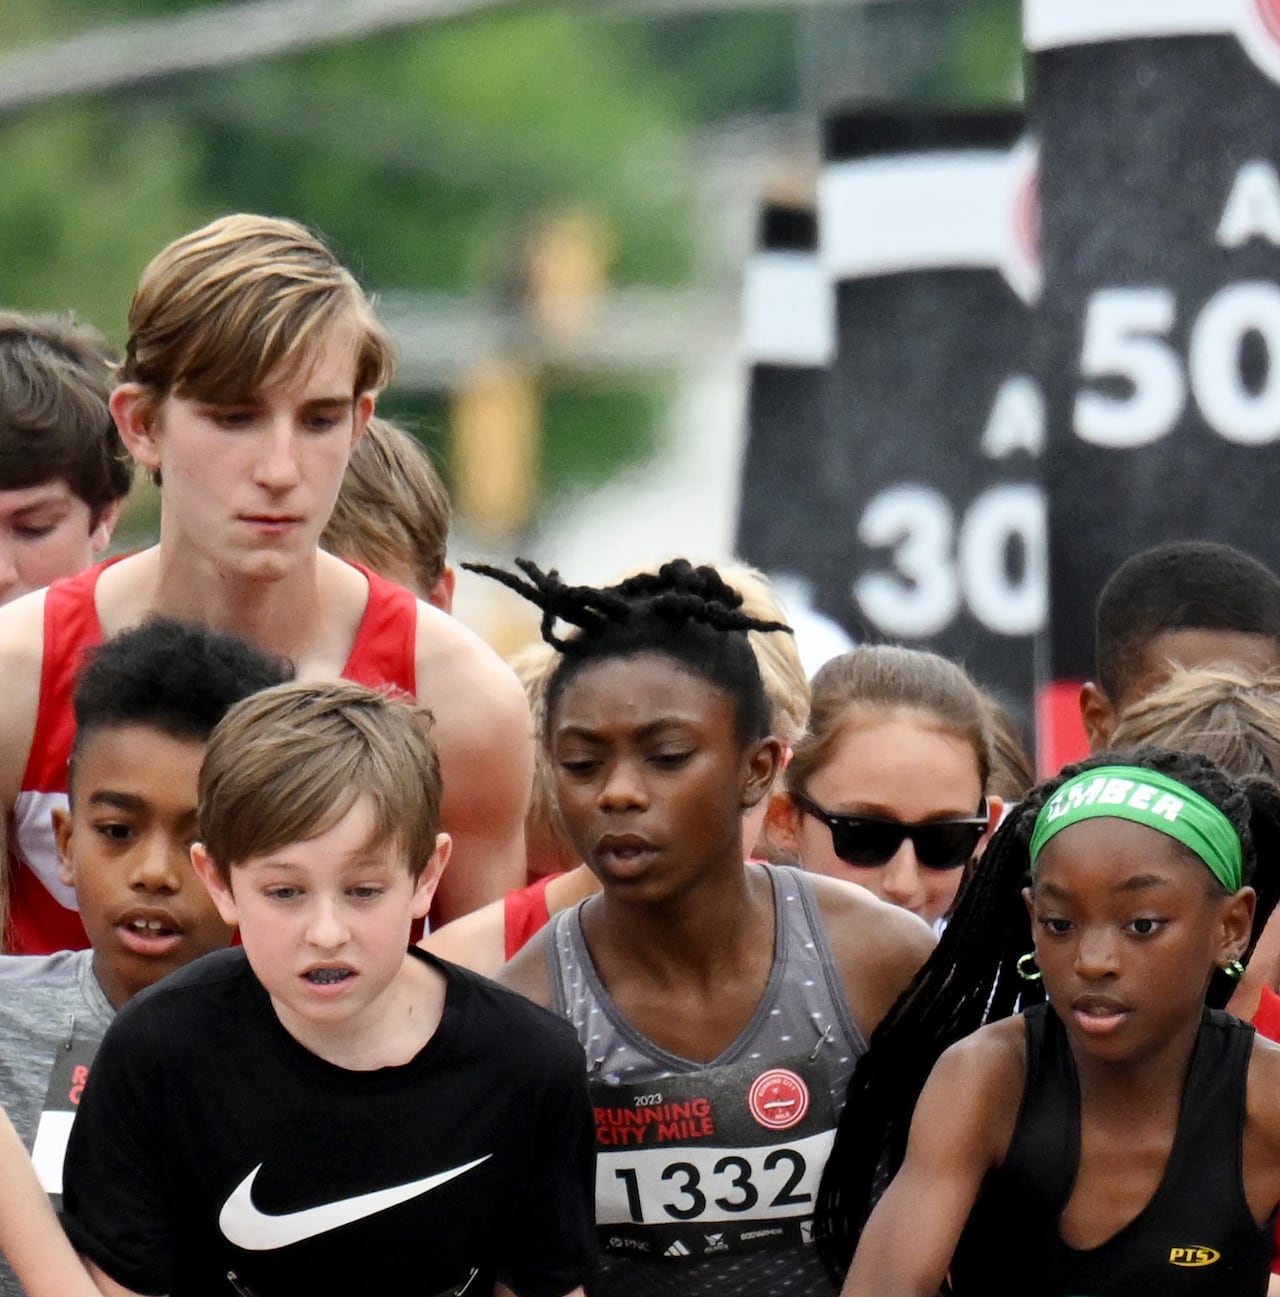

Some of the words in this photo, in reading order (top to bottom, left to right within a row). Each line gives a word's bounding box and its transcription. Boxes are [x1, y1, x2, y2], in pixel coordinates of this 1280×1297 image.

[593, 1097, 713, 1126] RUNNING
[633, 1092, 662, 1107] 2023
[596, 1126, 647, 1146] CITY
[657, 1117, 715, 1142] MILE
[614, 1148, 812, 1223] 1332
[1169, 1247, 1209, 1263] PTS
